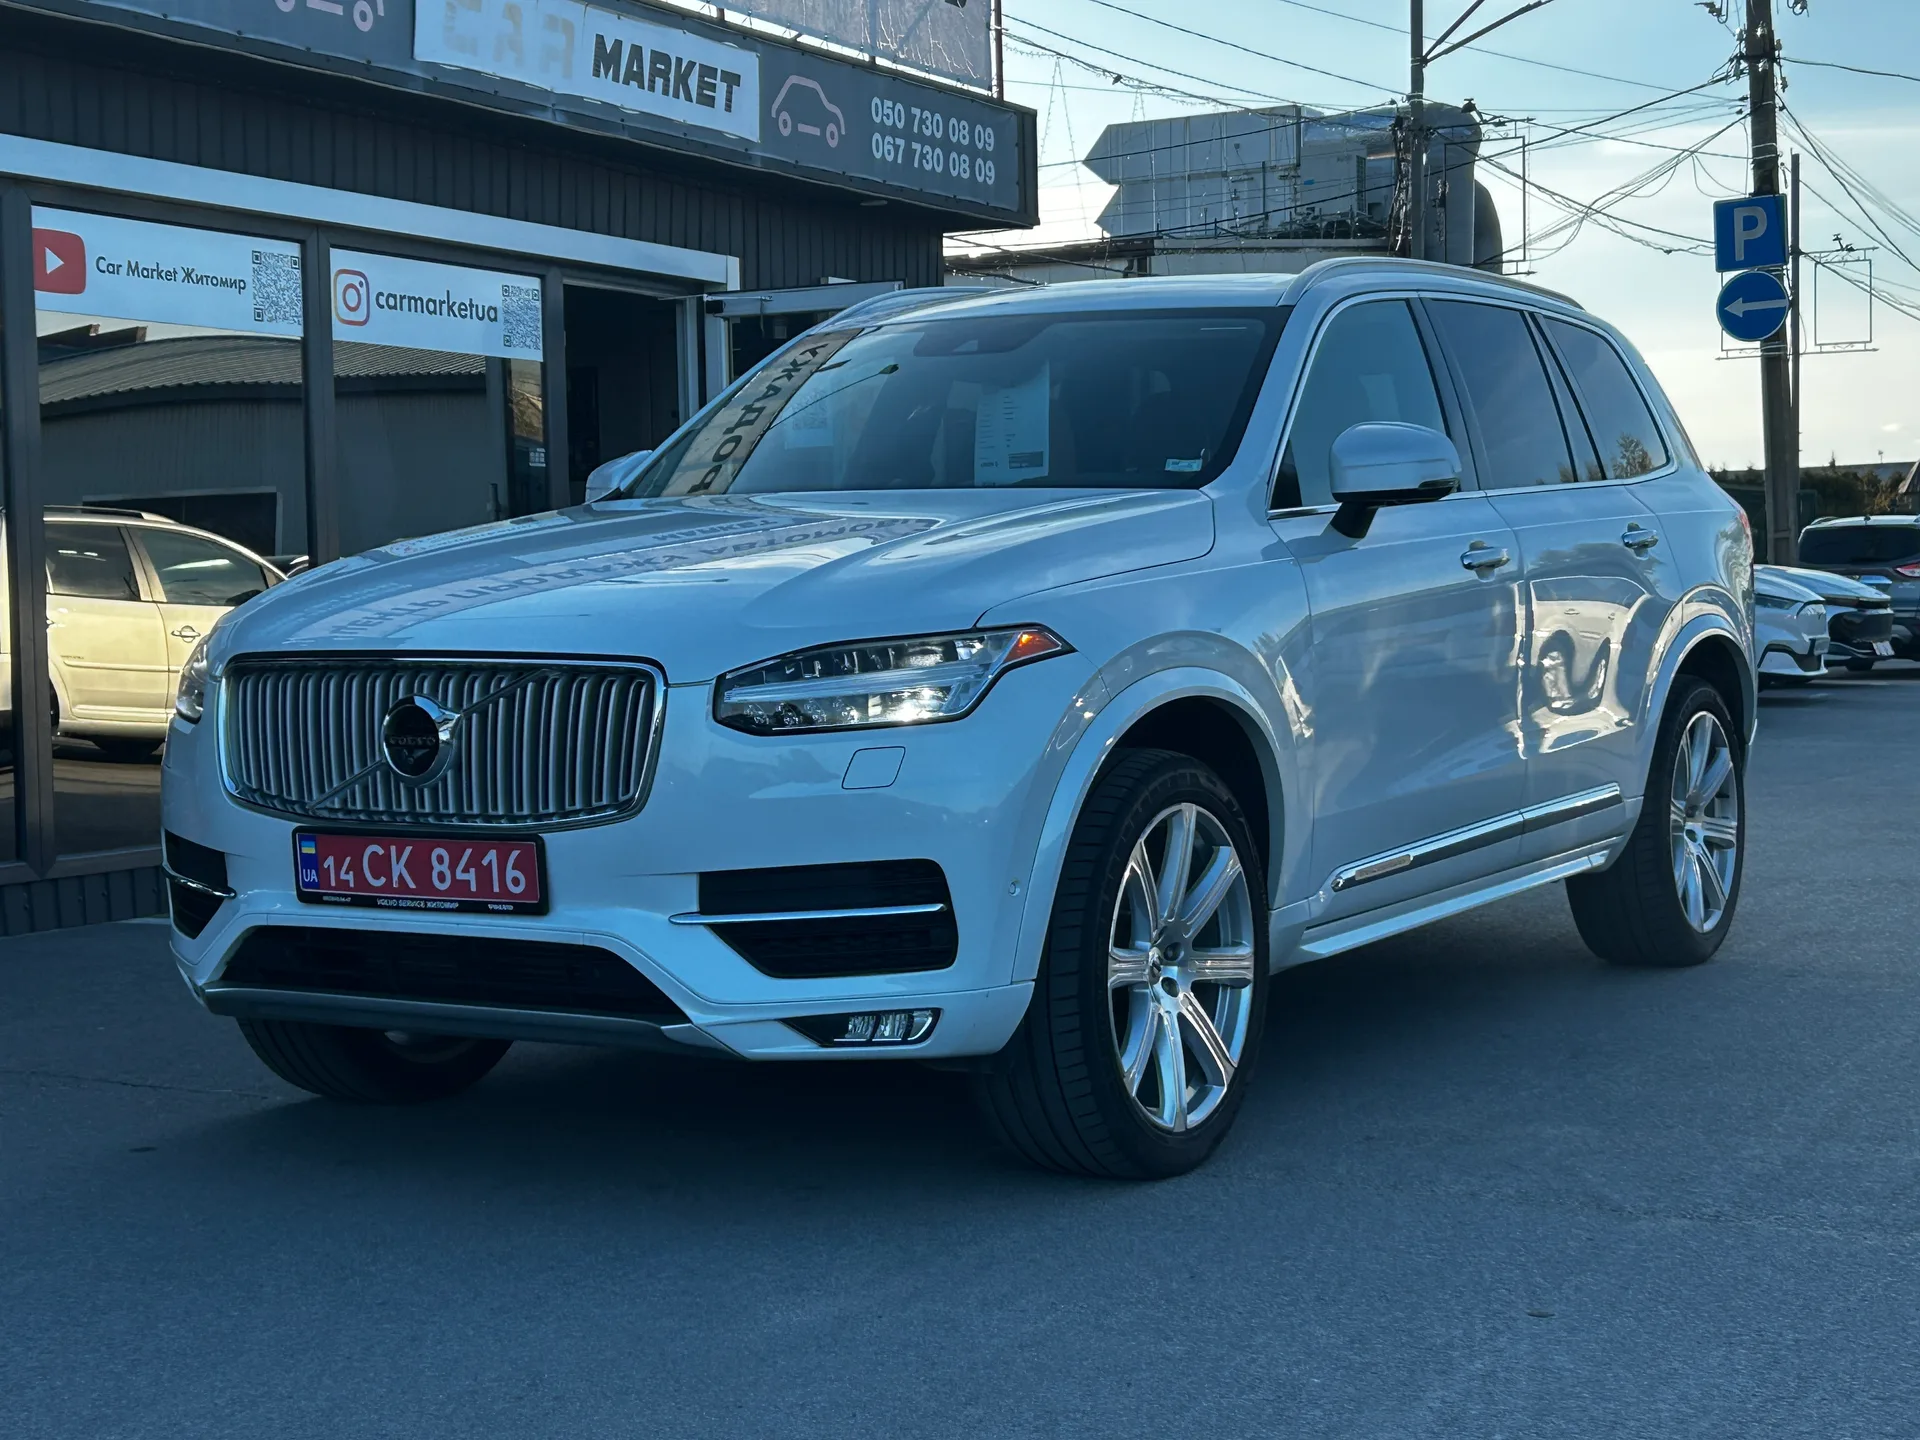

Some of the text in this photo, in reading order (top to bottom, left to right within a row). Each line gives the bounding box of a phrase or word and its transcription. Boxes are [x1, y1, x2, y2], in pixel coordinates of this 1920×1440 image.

[592, 33, 742, 114] MARKET
[871, 96, 995, 152] 050 730 08 09
[871, 132, 996, 185] 067 730 08 09
[1733, 205, 1768, 262] P
[95, 256, 247, 295] Car Market Житомир
[375, 289, 498, 323] carmarketua
[302, 868, 318, 883] UA
[322, 844, 526, 894] 14 CK 8416
